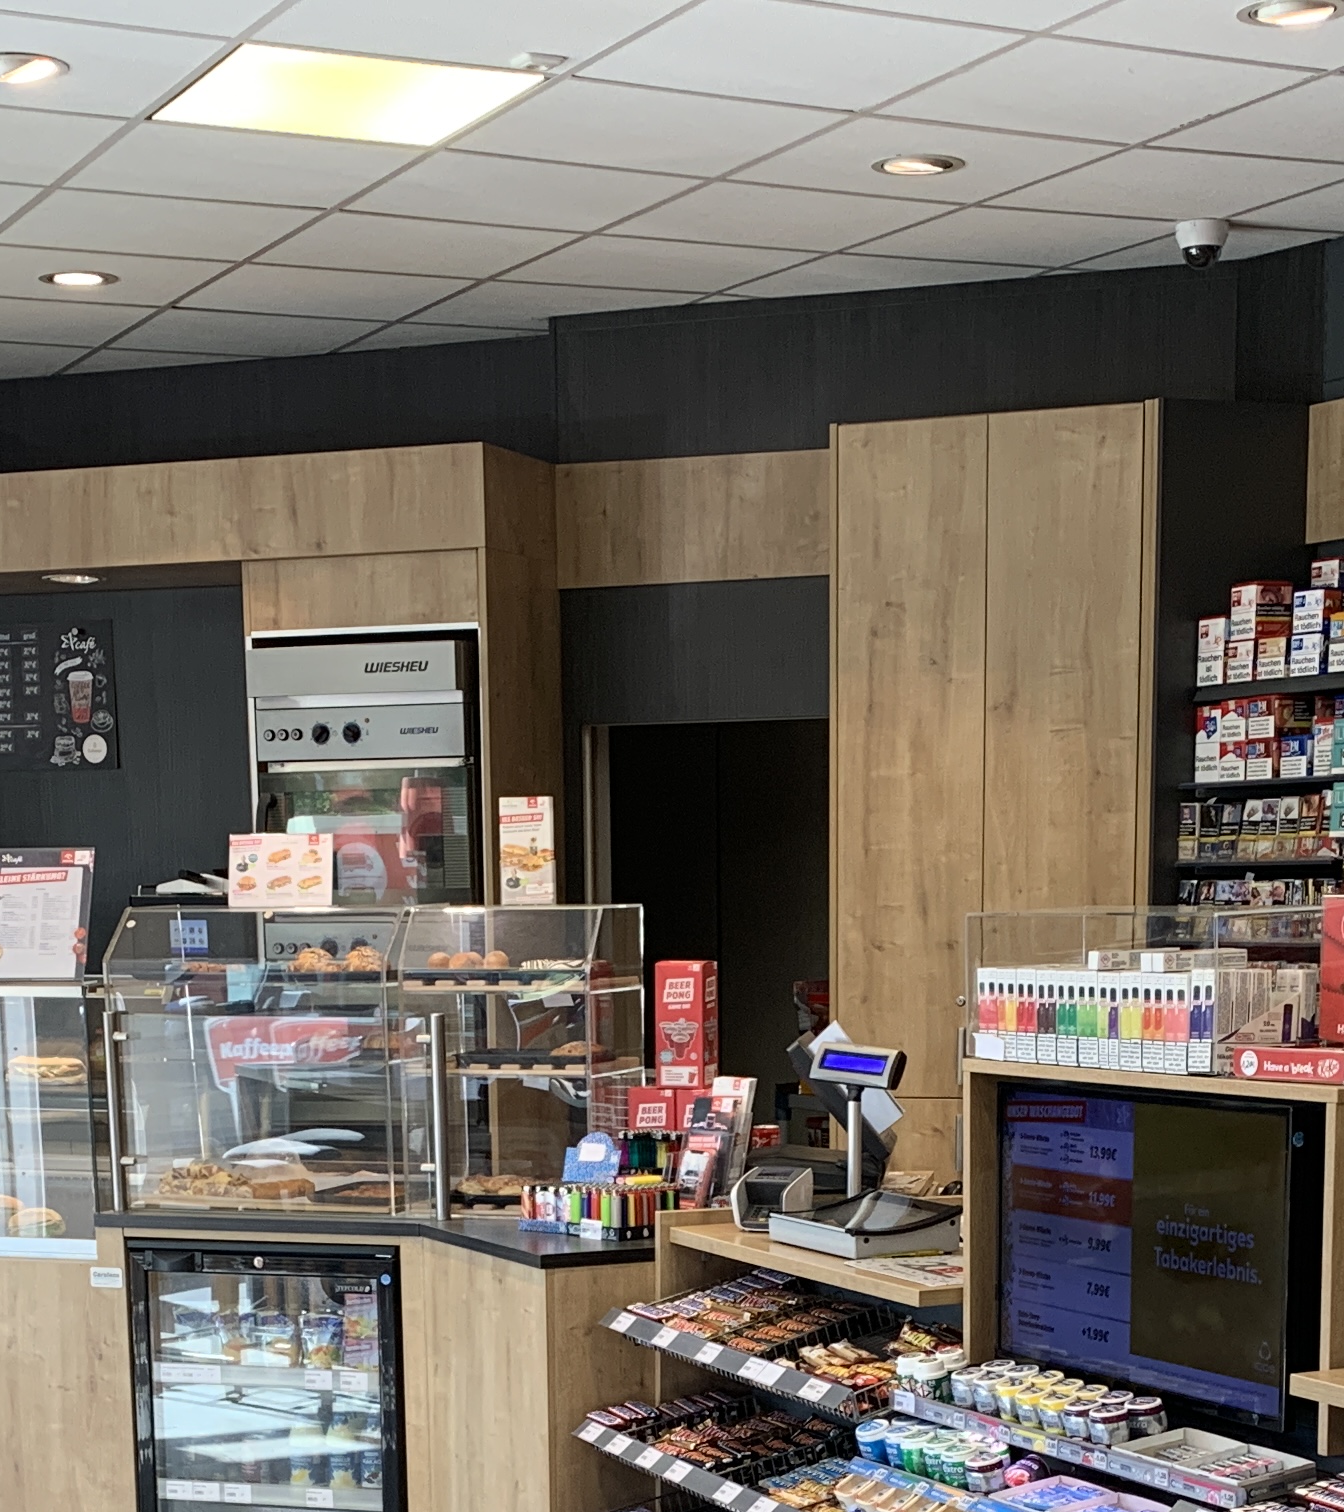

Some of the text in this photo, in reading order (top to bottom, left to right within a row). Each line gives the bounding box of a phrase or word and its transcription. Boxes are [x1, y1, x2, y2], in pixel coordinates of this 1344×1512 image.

[364, 660, 429, 674] WIESHEU
[400, 726, 439, 735] WIESHEU
[668, 979, 692, 991] BEER
[665, 990, 692, 1002] PONG
[1263, 1060, 1314, 1075] Have a break
[641, 1104, 664, 1116] BEER
[638, 1114, 664, 1127] PONG
[1156, 1216, 1255, 1252] einzigartiges
[1154, 1246, 1262, 1285] Tabakerlebnis.
